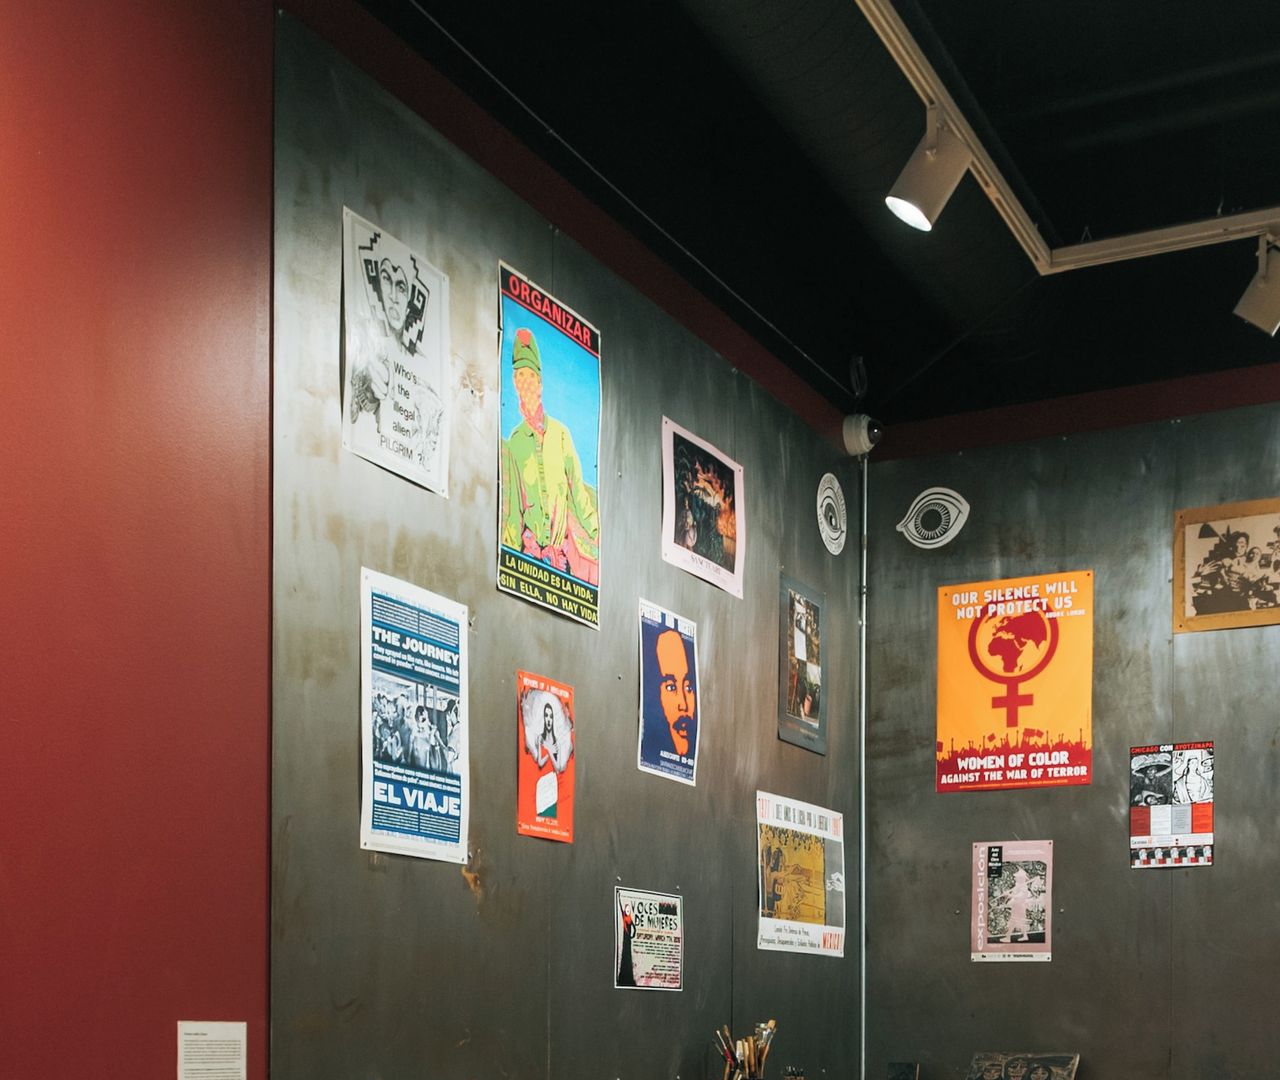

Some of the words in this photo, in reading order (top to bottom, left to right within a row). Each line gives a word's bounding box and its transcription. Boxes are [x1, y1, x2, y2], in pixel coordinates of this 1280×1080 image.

[509, 275, 591, 346] ORGANIZAR
[394, 361, 417, 384] Who's
[398, 384, 410, 399] the
[393, 401, 415, 421] illegal
[392, 421, 411, 438] alien
[380, 434, 413, 460] PILGRIM
[505, 554, 516, 569] LA
[517, 559, 550, 583] UNIDAD
[550, 574, 561, 588] ES
[561, 579, 572, 593] LA
[573, 583, 594, 603] VIDA;
[500, 574, 516, 590] SIN
[520, 581, 543, 601] ELLA,
[545, 591, 559, 606] NO
[561, 598, 579, 614] HAY
[952, 591, 978, 606] OUR
[984, 585, 1040, 603] SILENCE
[1045, 580, 1078, 594] WILL
[956, 605, 983, 620] NOT
[988, 598, 1049, 617] PROTECT
[1054, 596, 1073, 610] US
[372, 626, 400, 647] THE
[402, 636, 460, 666] JOURNEY
[1131, 745, 1159, 754] CHICAGO
[1160, 744, 1174, 752] CON
[1174, 742, 1214, 751] AYOTZINAPA
[957, 755, 1005, 771] WOMEN
[1008, 754, 1024, 767] OF
[1028, 751, 1069, 766] COLOR
[941, 772, 981, 784] AGAINST
[984, 770, 1003, 781] THE
[1006, 769, 1027, 780] WAR
[1031, 768, 1044, 779] OF
[1047, 766, 1088, 778] TERROR
[374, 781, 401, 805] EL
[403, 787, 460, 816] VIAJE
[631, 899, 658, 916] VOCES
[635, 914, 644, 927] DE
[647, 915, 678, 931] MUJERES
